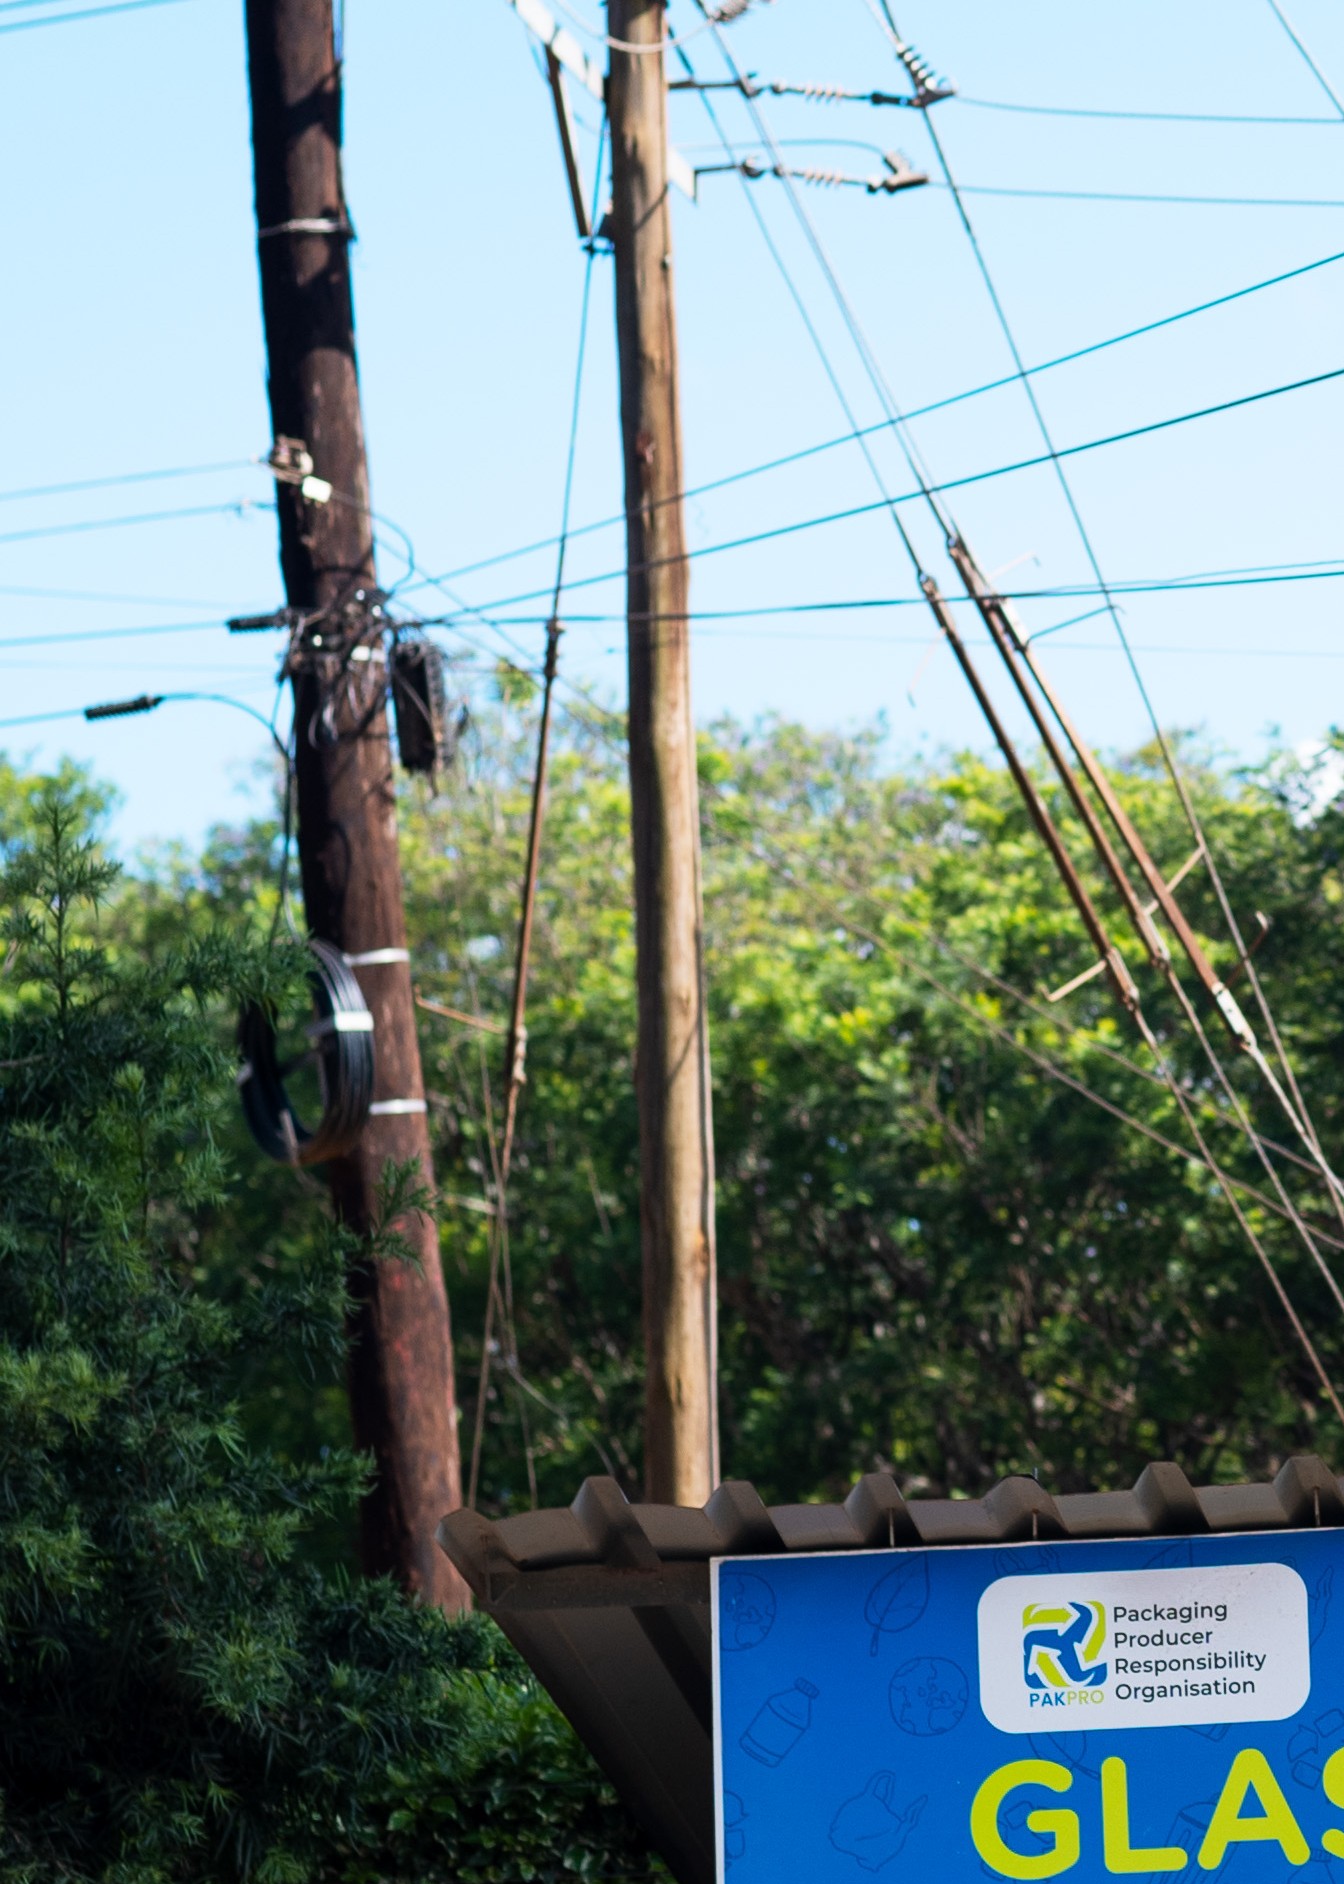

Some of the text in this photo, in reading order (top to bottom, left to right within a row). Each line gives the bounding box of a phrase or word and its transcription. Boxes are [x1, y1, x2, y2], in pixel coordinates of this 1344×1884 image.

[1114, 1603, 1227, 1623] Packaging
[1115, 1630, 1213, 1648] Producer
[1115, 1651, 1266, 1676] Responsibility
[1030, 1690, 1104, 1707] PAKPRO
[1116, 1678, 1255, 1702] Organisation
